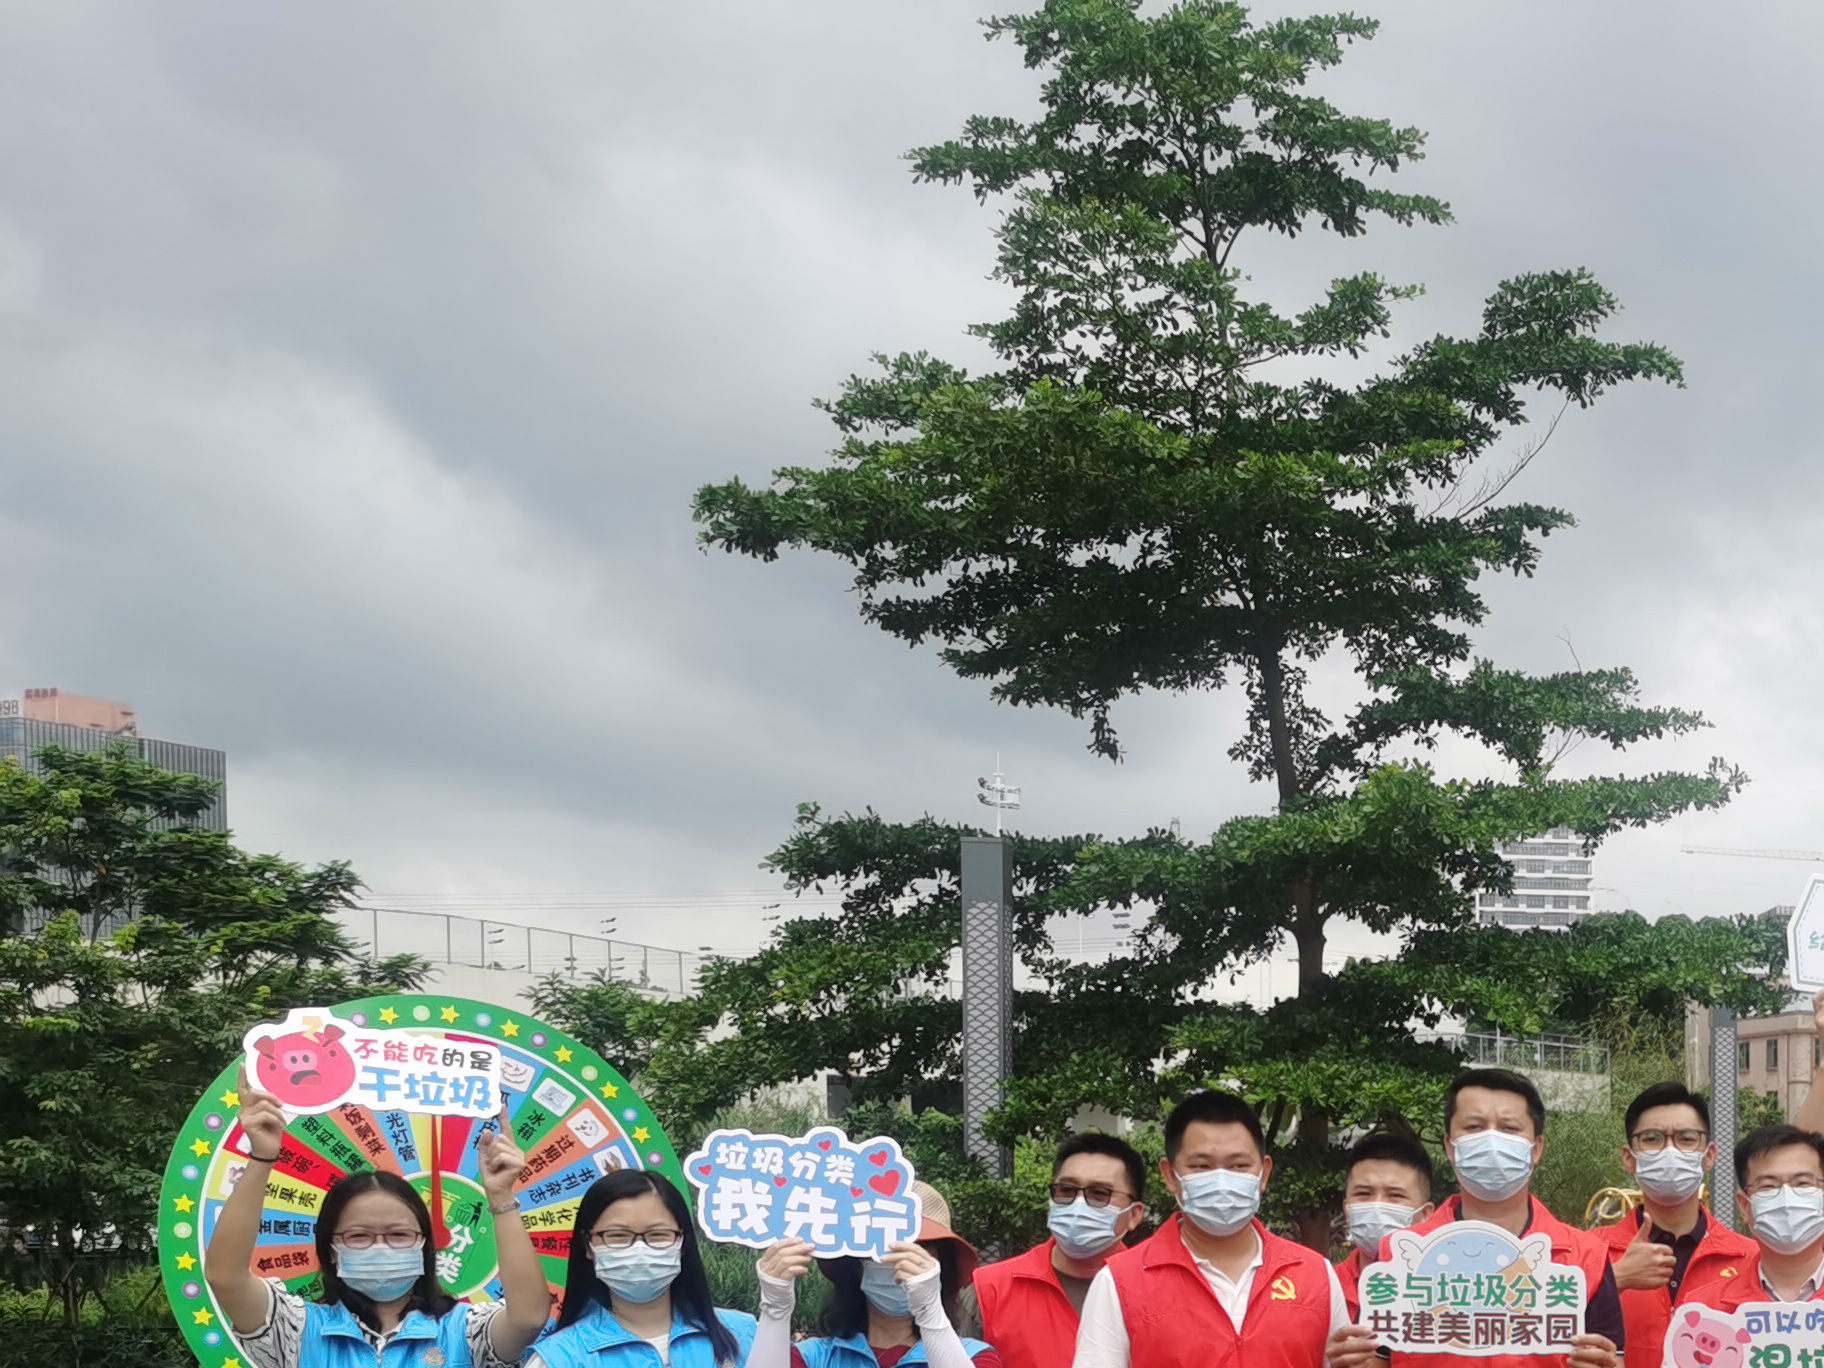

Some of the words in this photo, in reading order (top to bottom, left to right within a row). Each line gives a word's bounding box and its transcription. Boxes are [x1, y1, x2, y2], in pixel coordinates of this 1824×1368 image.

[353, 1038, 493, 1071] 不能吃的是
[358, 1065, 492, 1110] 干垃圾
[386, 1112, 416, 1162] 光灯管
[715, 1142, 856, 1186] 垃圾分类
[520, 1206, 580, 1230] 化学品
[712, 1176, 909, 1252] 我先行
[256, 1249, 310, 1273] 食品袋
[1366, 1272, 1578, 1308] 参与垃圾分类
[1368, 1310, 1578, 1346] 共建美丽家园
